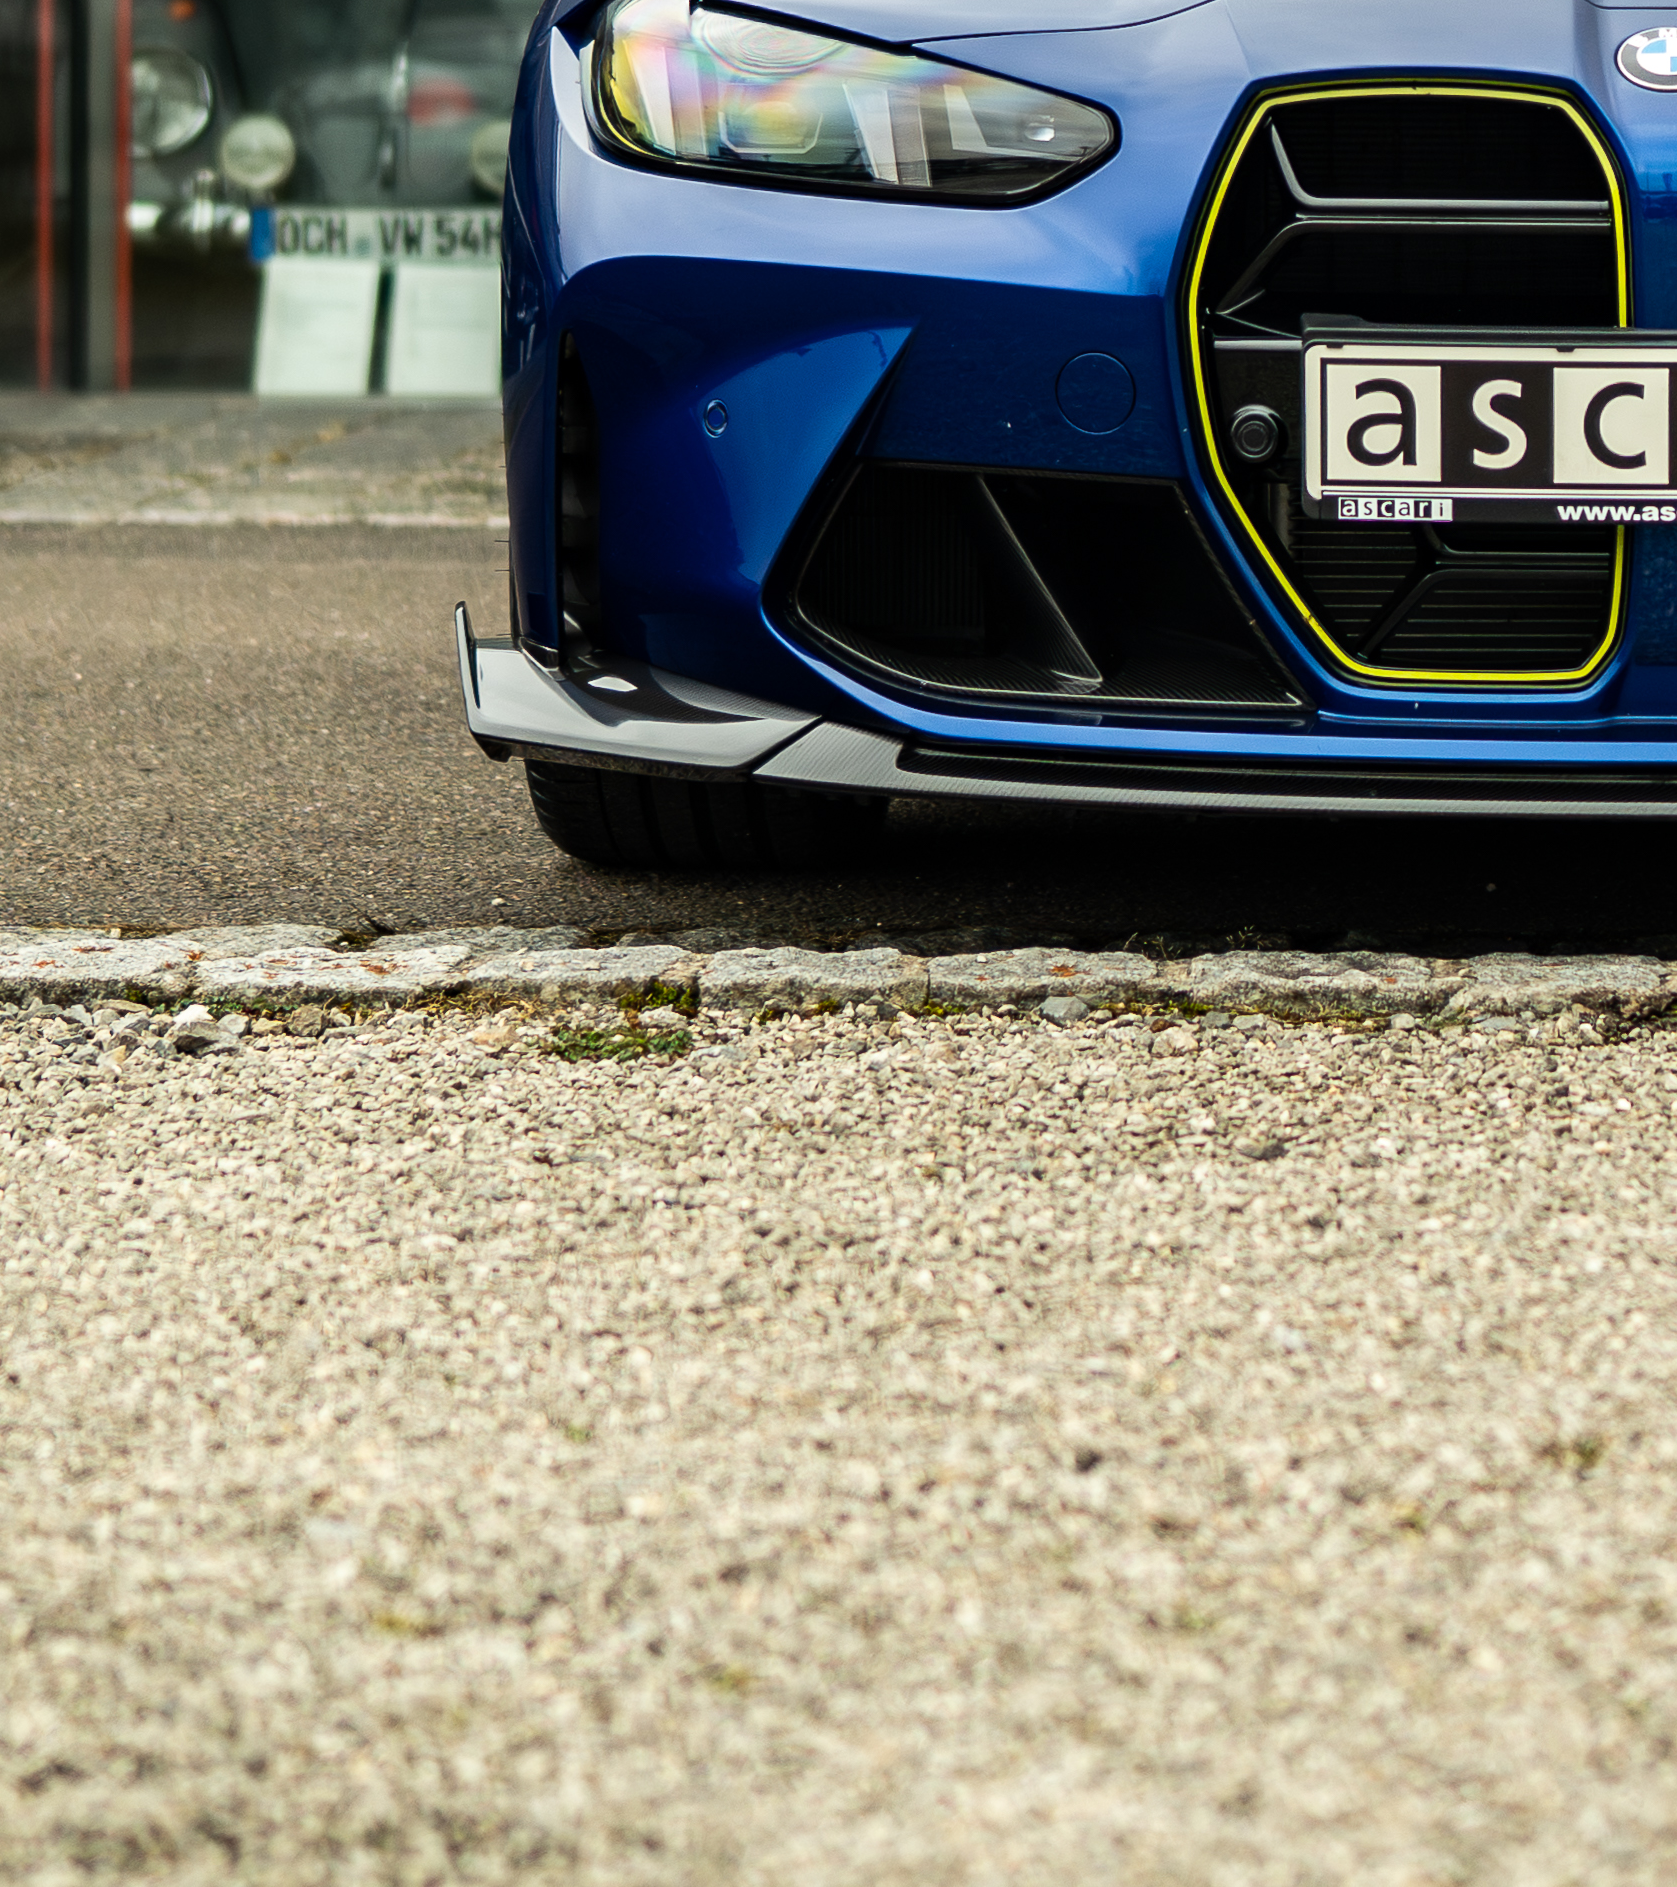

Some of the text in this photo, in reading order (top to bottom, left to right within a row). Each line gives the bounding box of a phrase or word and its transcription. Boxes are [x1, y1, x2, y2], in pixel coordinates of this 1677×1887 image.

[279, 216, 347, 255] OCH
[379, 216, 423, 255] VW
[1342, 499, 1444, 517] ascari
